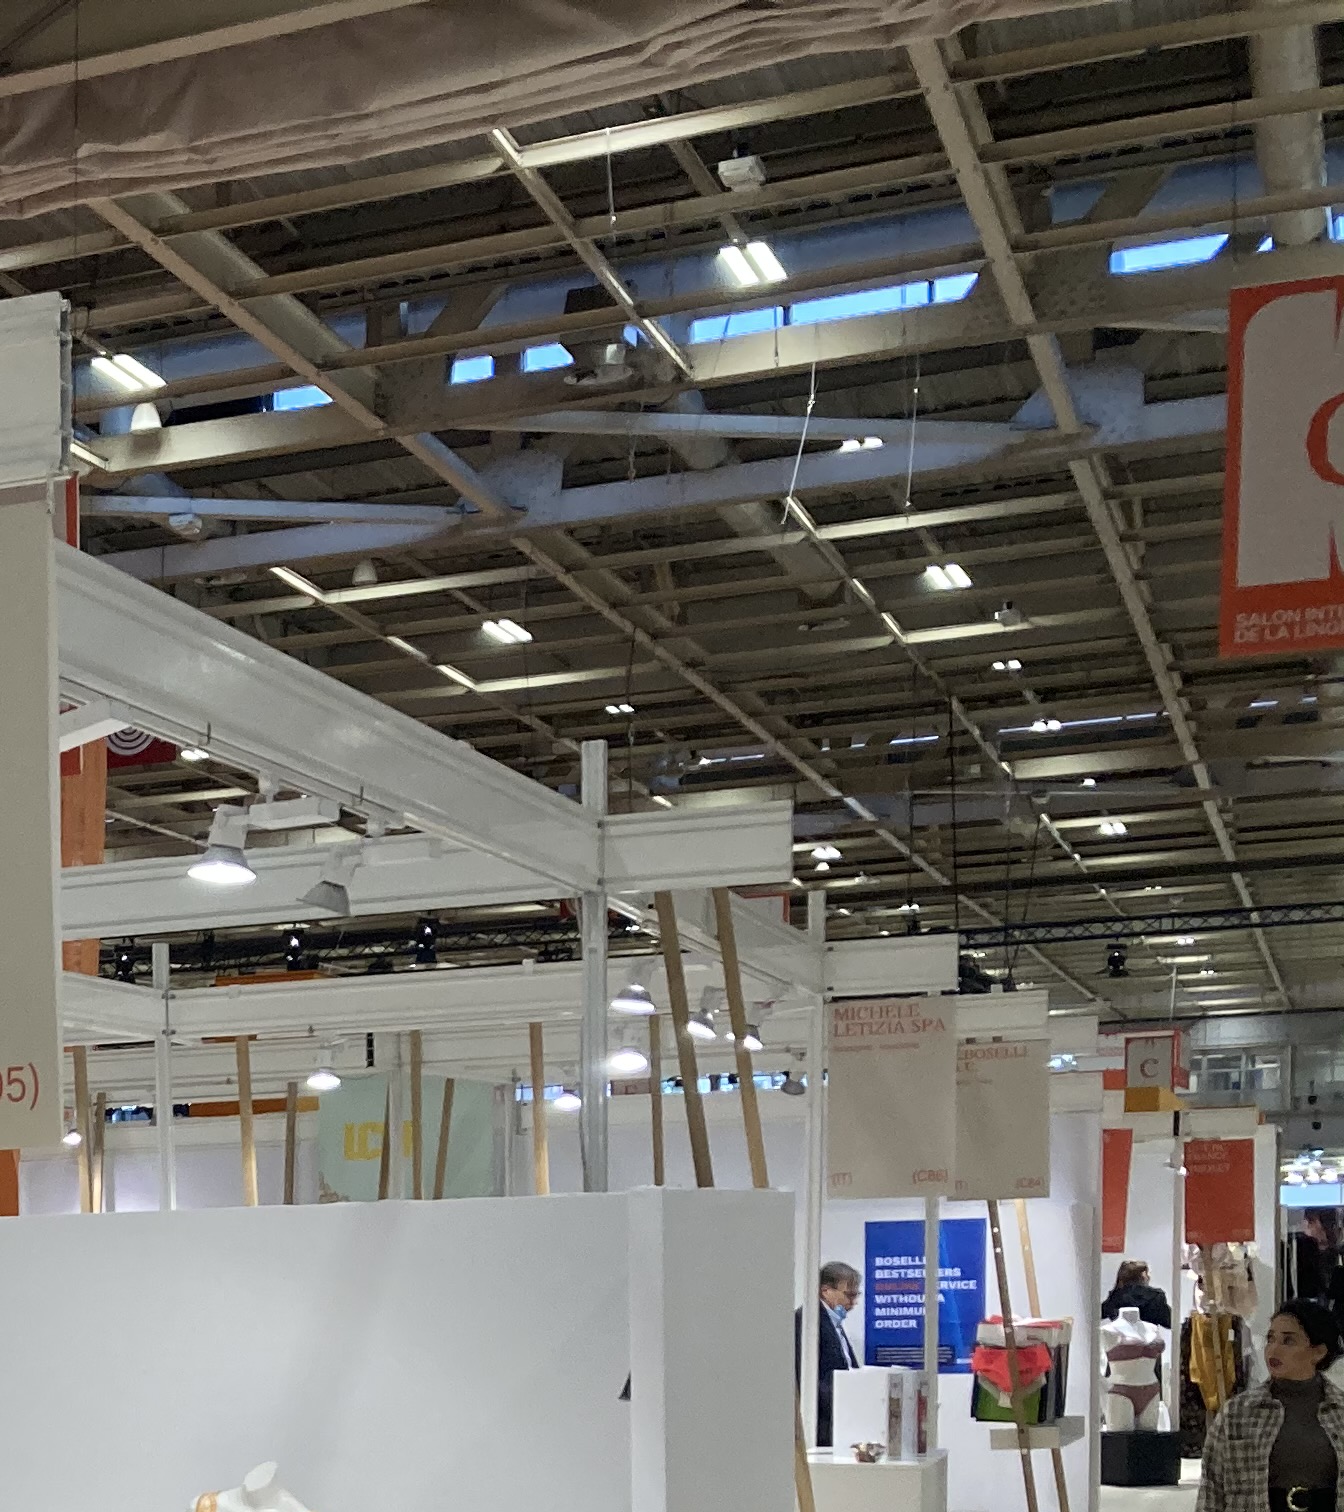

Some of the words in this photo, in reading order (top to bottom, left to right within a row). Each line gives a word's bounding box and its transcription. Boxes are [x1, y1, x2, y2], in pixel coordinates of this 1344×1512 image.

[833, 1003, 920, 1022] MICHELE
[833, 1021, 905, 1037] LETIZIA
[911, 1018, 946, 1034] SPA
[1139, 1057, 1160, 1079] C
[874, 1295, 925, 1304] WITHOU
[874, 1319, 917, 1329] ORDER
